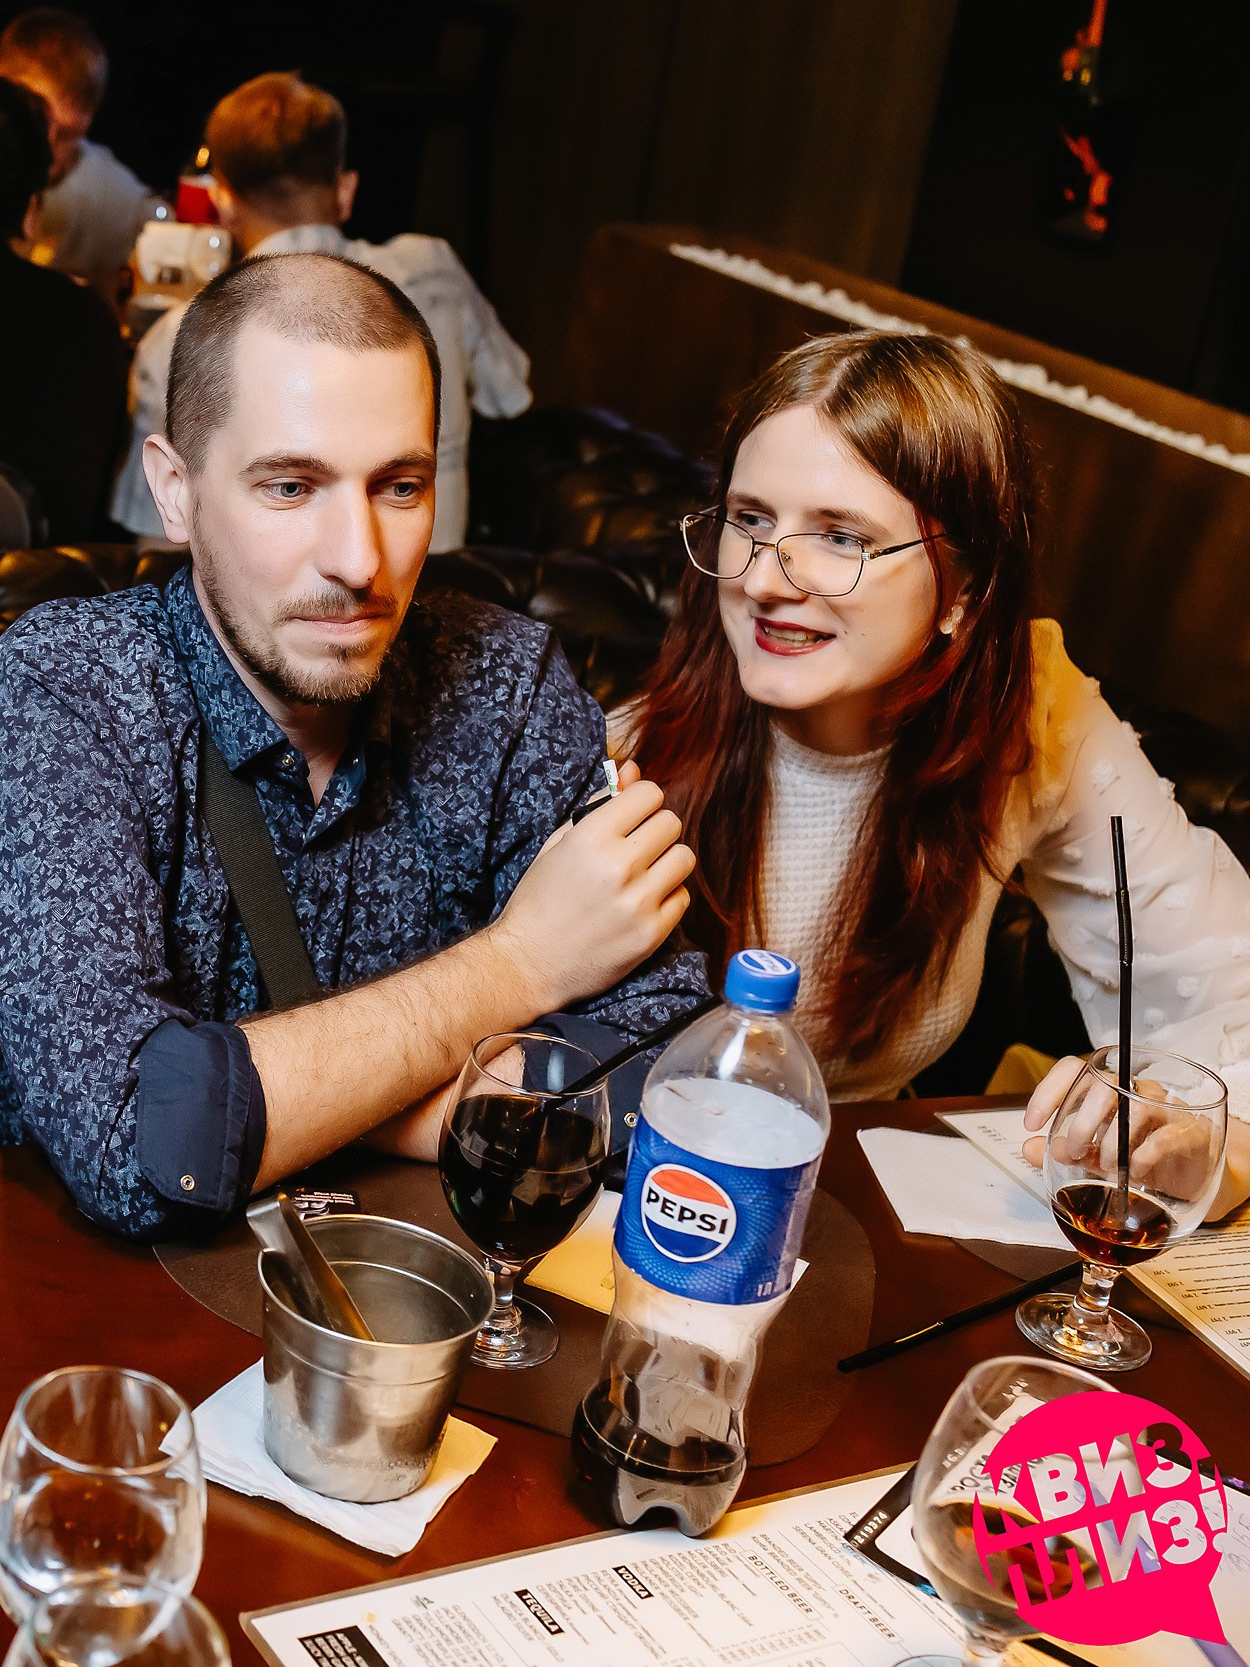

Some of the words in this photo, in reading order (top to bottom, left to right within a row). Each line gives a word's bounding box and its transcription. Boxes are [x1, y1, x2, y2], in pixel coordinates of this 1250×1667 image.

[646, 1186, 728, 1235] PEPSI
[617, 1567, 650, 1597] VODKA
[748, 1555, 790, 1590] BOTTLED
[787, 1592, 814, 1613] BEER
[519, 1592, 562, 1632] TEQUILA
[840, 1589, 871, 1615] DRAFT
[870, 1617, 896, 1638] BEER
